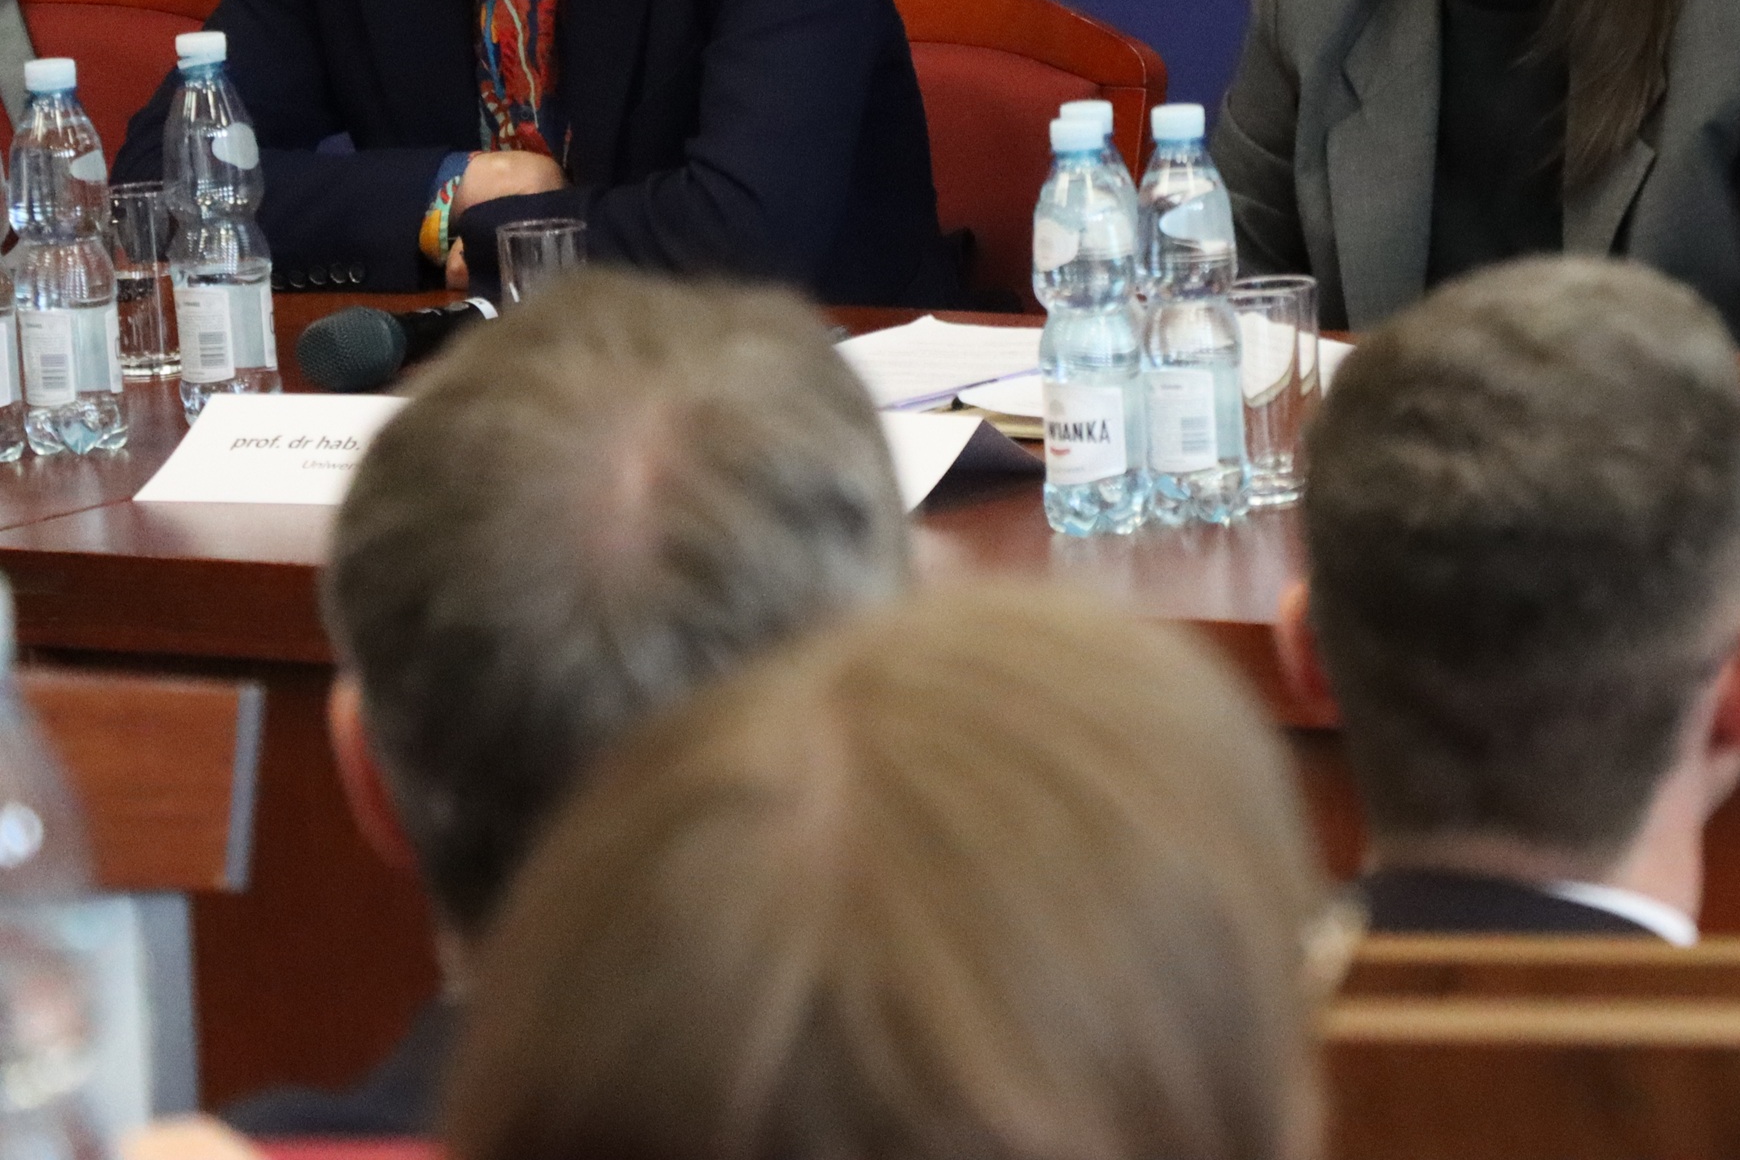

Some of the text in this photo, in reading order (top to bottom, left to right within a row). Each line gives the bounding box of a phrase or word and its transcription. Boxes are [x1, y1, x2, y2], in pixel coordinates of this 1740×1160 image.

[230, 435, 361, 451] prof. dr hab.
